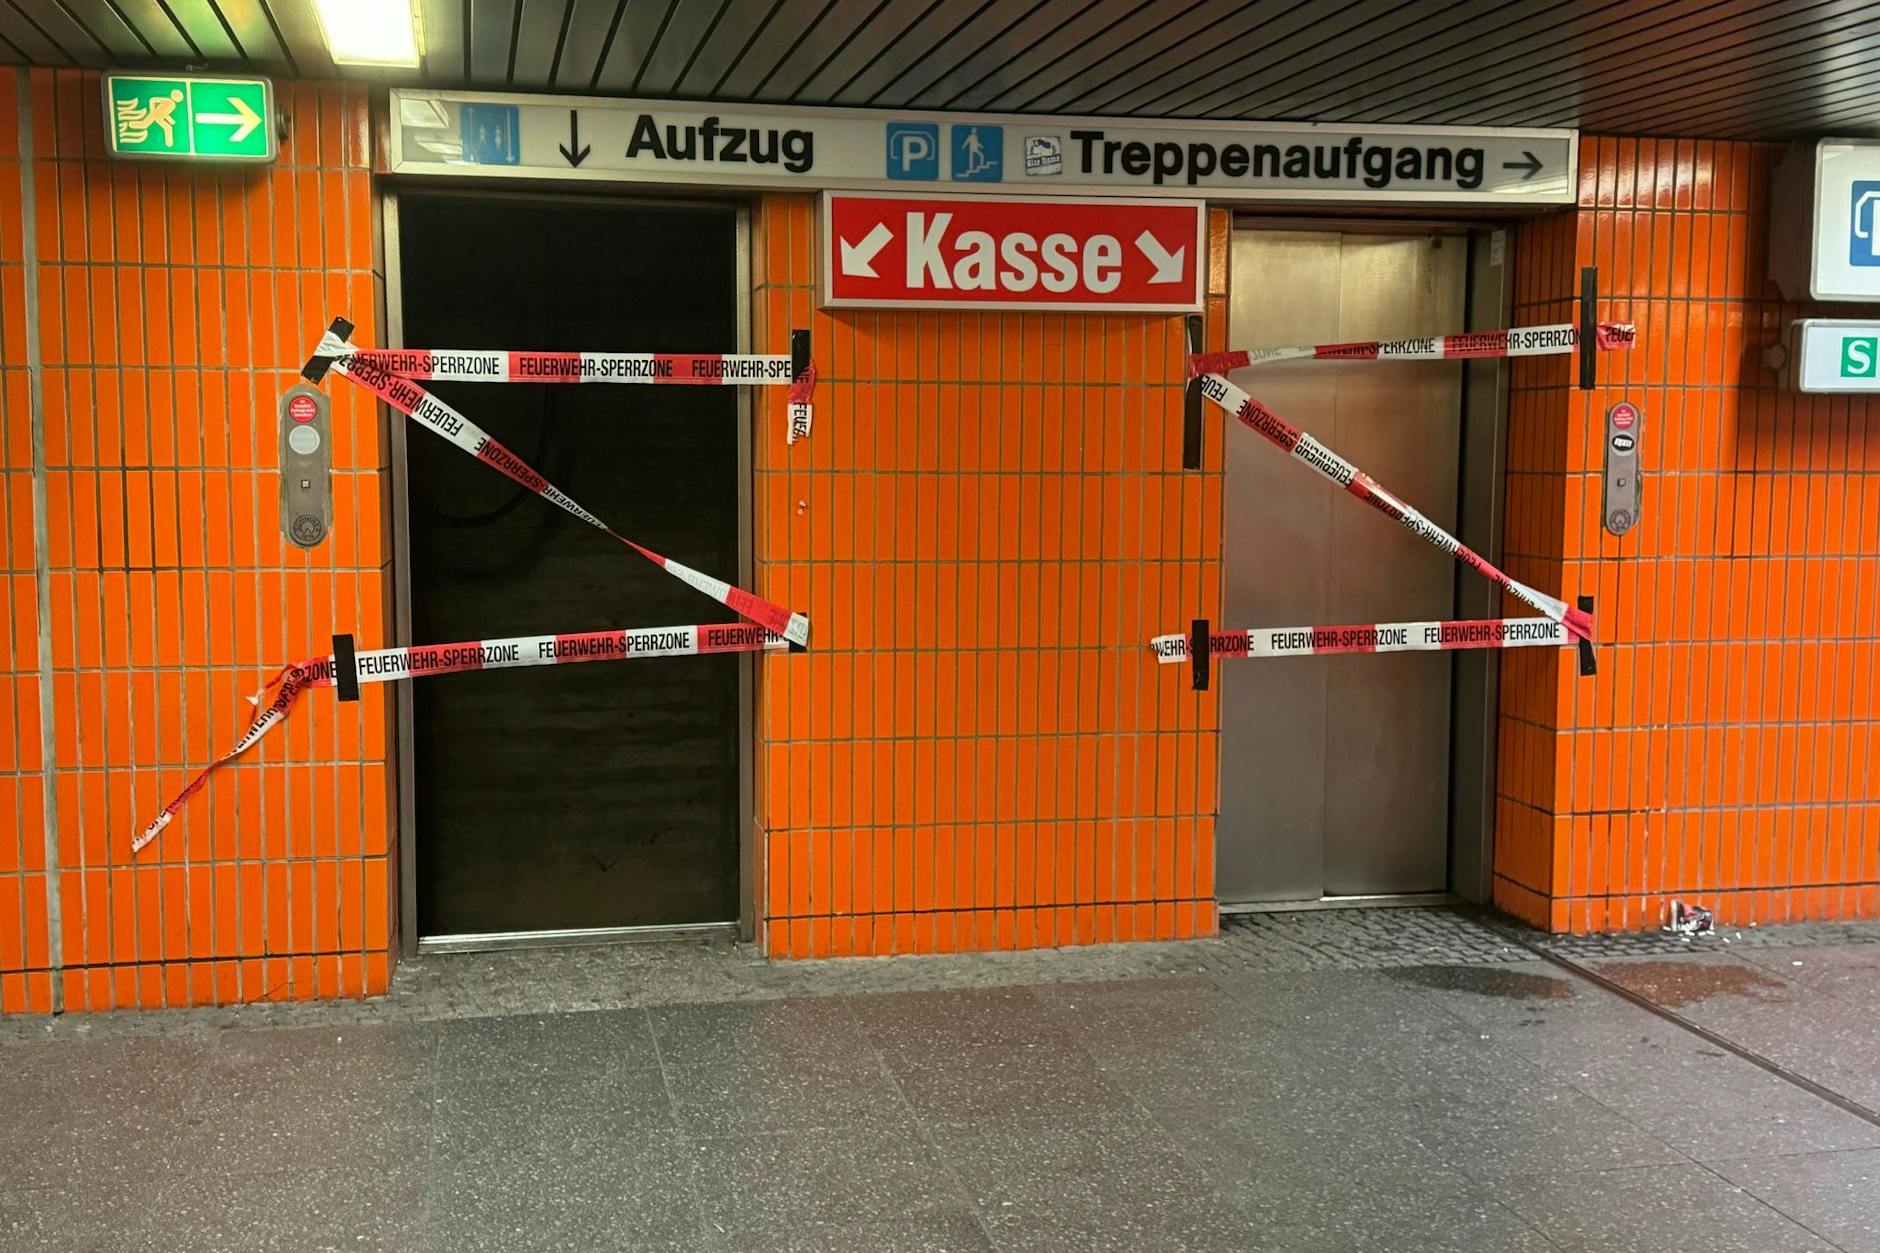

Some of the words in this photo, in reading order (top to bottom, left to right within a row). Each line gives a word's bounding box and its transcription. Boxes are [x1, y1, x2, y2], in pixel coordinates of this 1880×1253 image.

[626, 114, 813, 173] Aufzug
[903, 136, 928, 171] P
[1070, 130, 1485, 189] Treppenaufgang
[906, 212, 1122, 293] Kasse
[519, 357, 673, 377] FEUERWEHR-SPERRZONE
[1847, 339, 1871, 374] S
[358, 645, 519, 675] FEUERWEHR-SPERRZONE
[538, 632, 690, 658] FEUERWEHR-SPERRZONE
[708, 627, 790, 646] FEUERWEHR-
[1271, 629, 1407, 650] FEUERWEHR-SPERRZONE
[1424, 623, 1560, 643] FEUERWEHR-SPERRZONE
